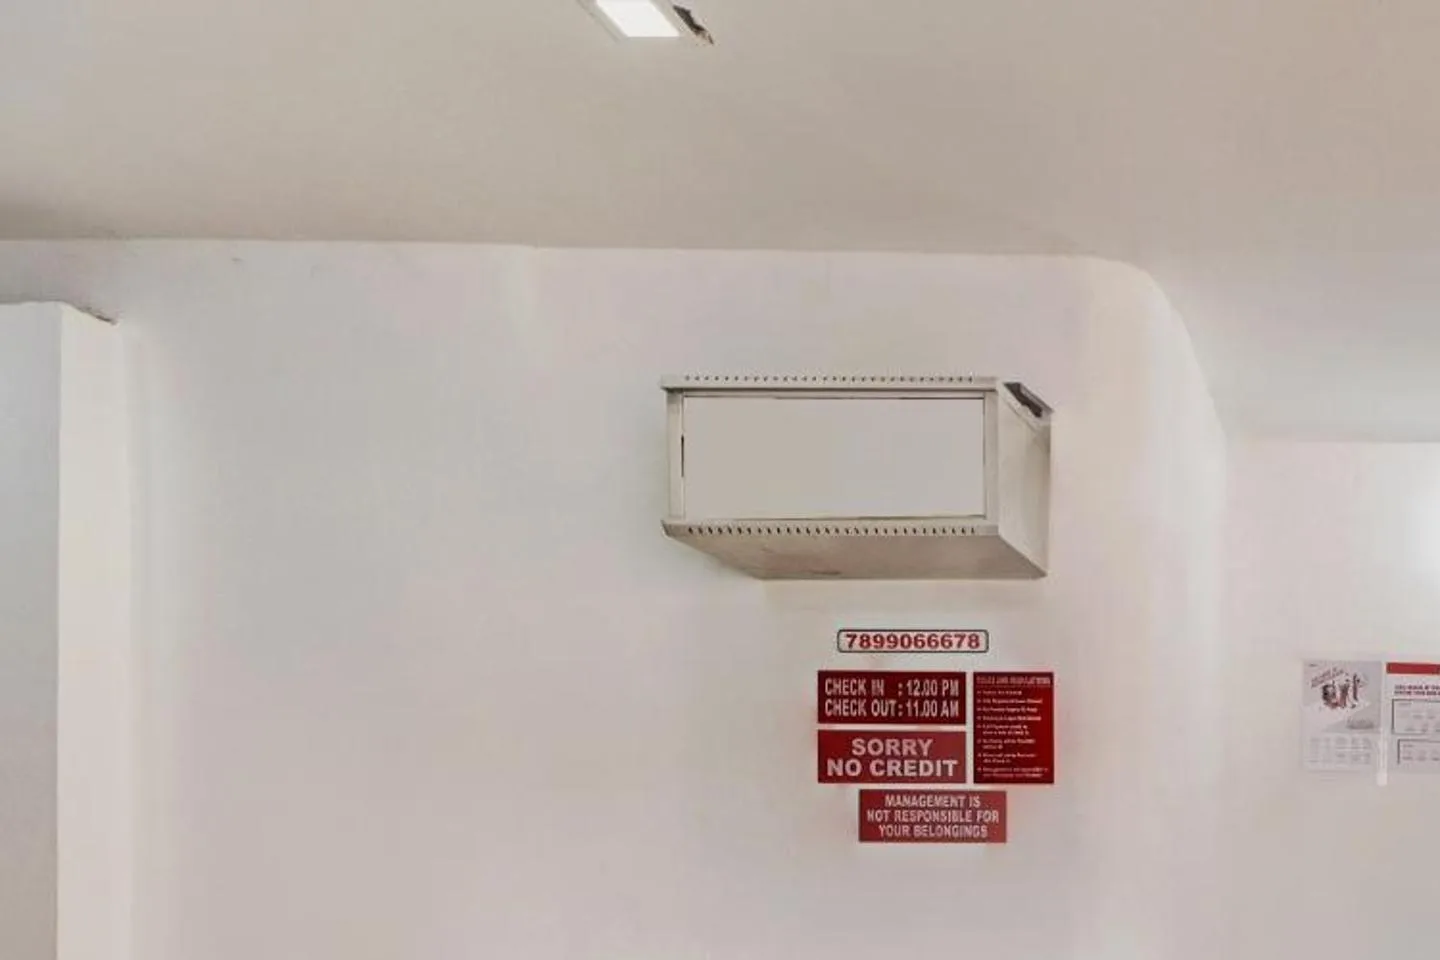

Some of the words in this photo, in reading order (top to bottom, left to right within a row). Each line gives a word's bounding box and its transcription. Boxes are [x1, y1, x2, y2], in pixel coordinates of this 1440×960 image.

[845, 633, 981, 649] 7899066678
[824, 678, 867, 696] CHECK
[871, 679, 885, 696] IN
[906, 679, 938, 697] 12.00
[942, 679, 960, 697] PM
[824, 699, 867, 717] CHECK
[940, 700, 960, 717] AM
[851, 738, 934, 756] SORRY
[826, 758, 863, 777] NO
[869, 759, 959, 777] CREDIT
[884, 794, 967, 809] MANAGEMENT
[969, 796, 981, 809] IS
[866, 809, 891, 823] NOT
[894, 809, 973, 823] RESPONSIBLE
[976, 809, 1000, 823] FOR
[879, 824, 911, 837] YOUR
[913, 824, 989, 838] BELONGINGS
